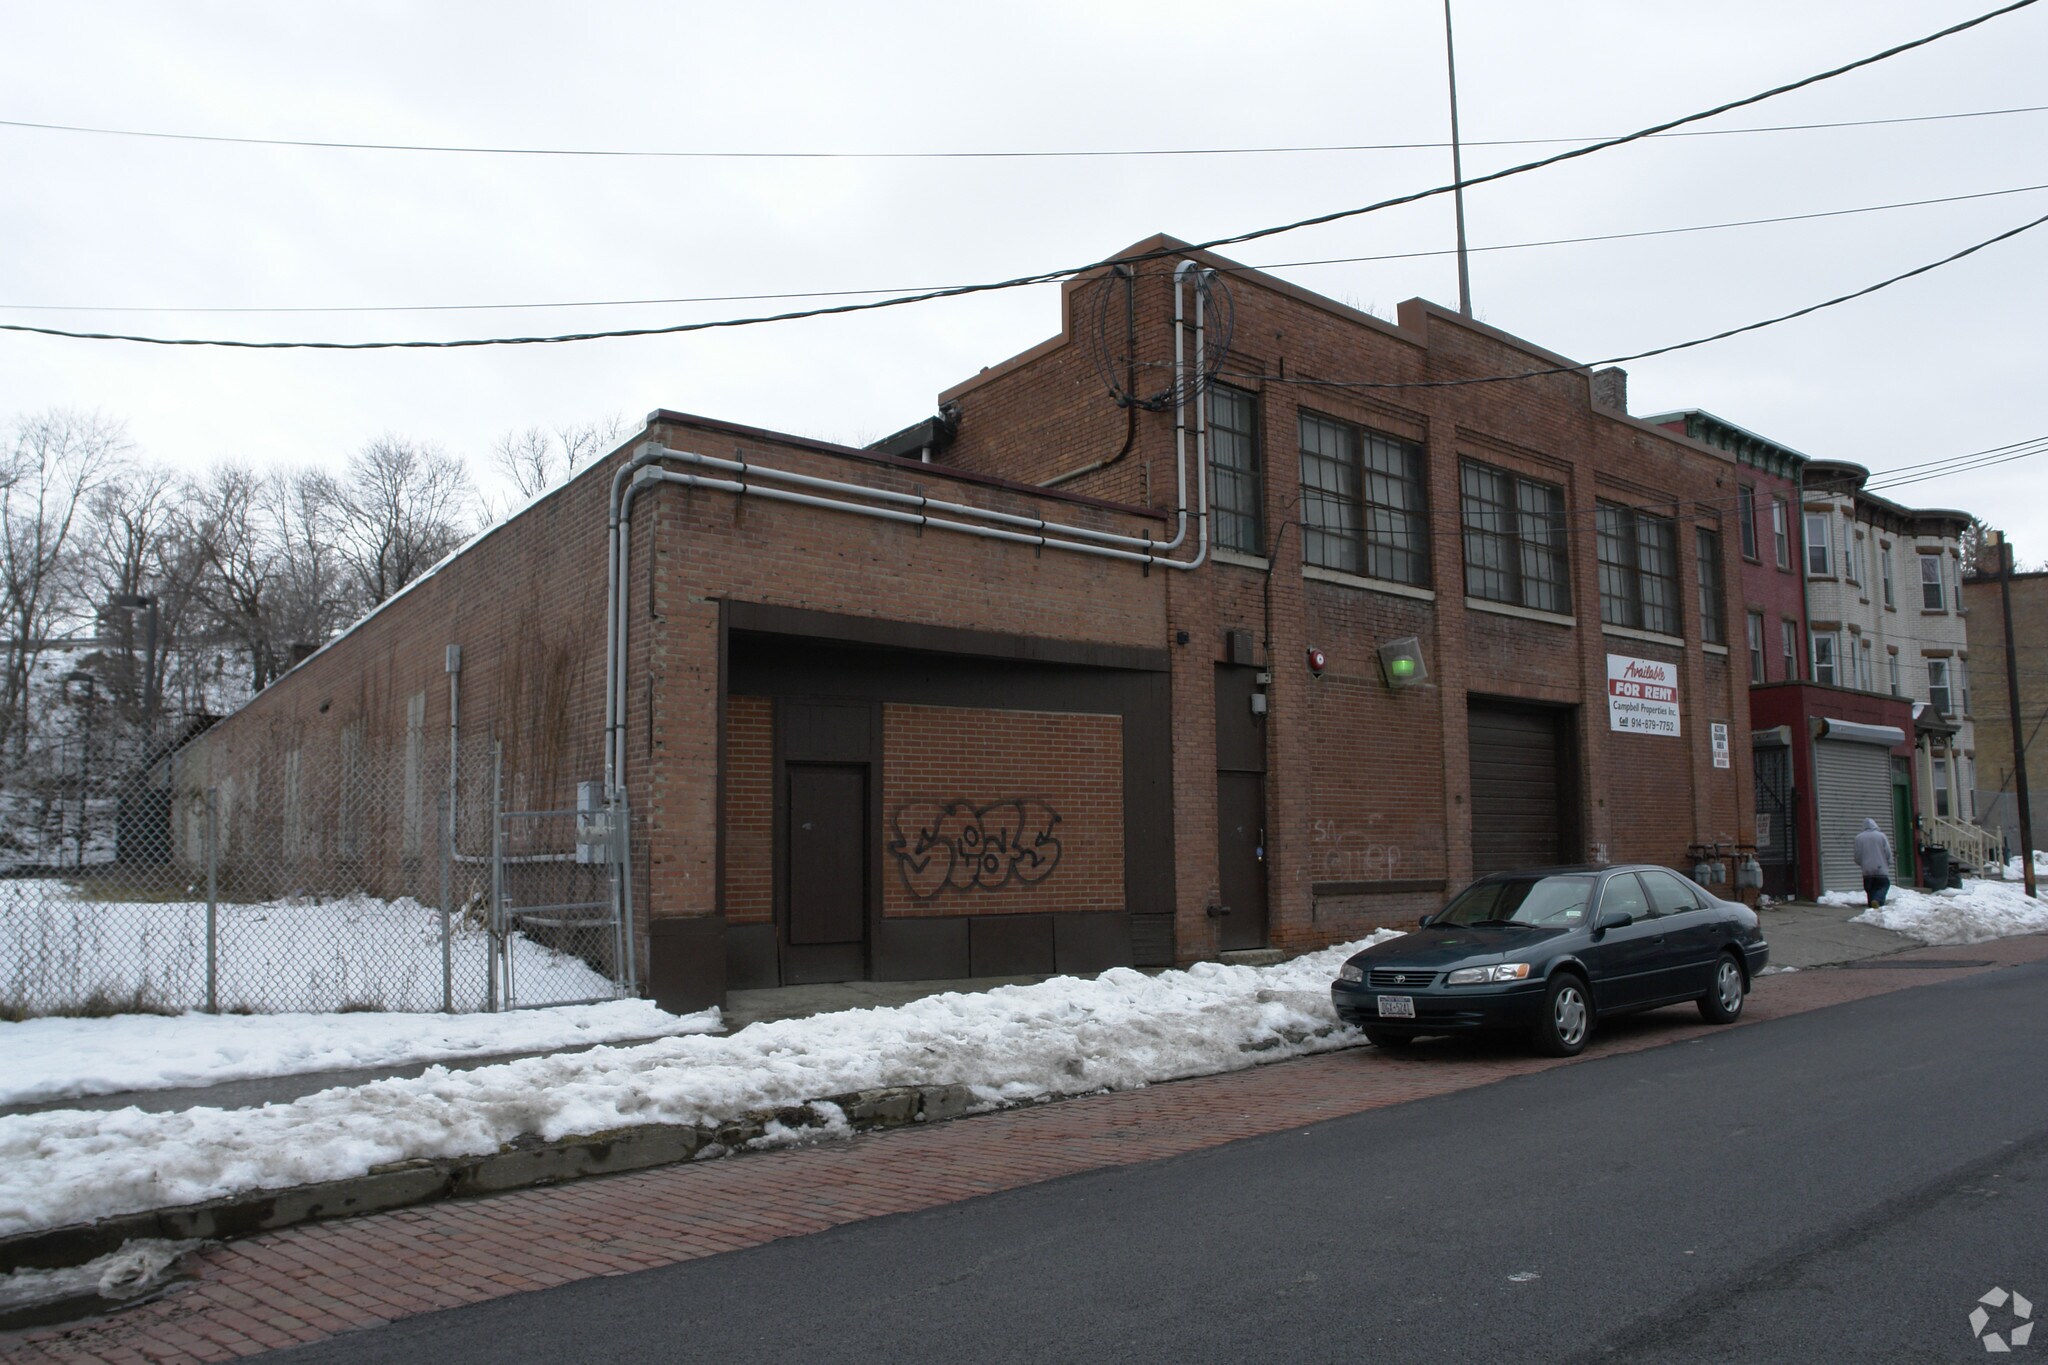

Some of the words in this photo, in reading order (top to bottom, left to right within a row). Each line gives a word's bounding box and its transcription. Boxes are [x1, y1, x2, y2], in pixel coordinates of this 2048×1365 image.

[1624, 661, 1665, 681] Available
[1615, 682, 1640, 697] FOR
[1644, 685, 1672, 701] RENT
[1613, 701, 1639, 713] Campbell
[1640, 703, 1667, 715] Properties
[1668, 708, 1677, 717] Inc.
[1619, 716, 1628, 726] Call
[1631, 718, 1674, 731] 914-879-7752
